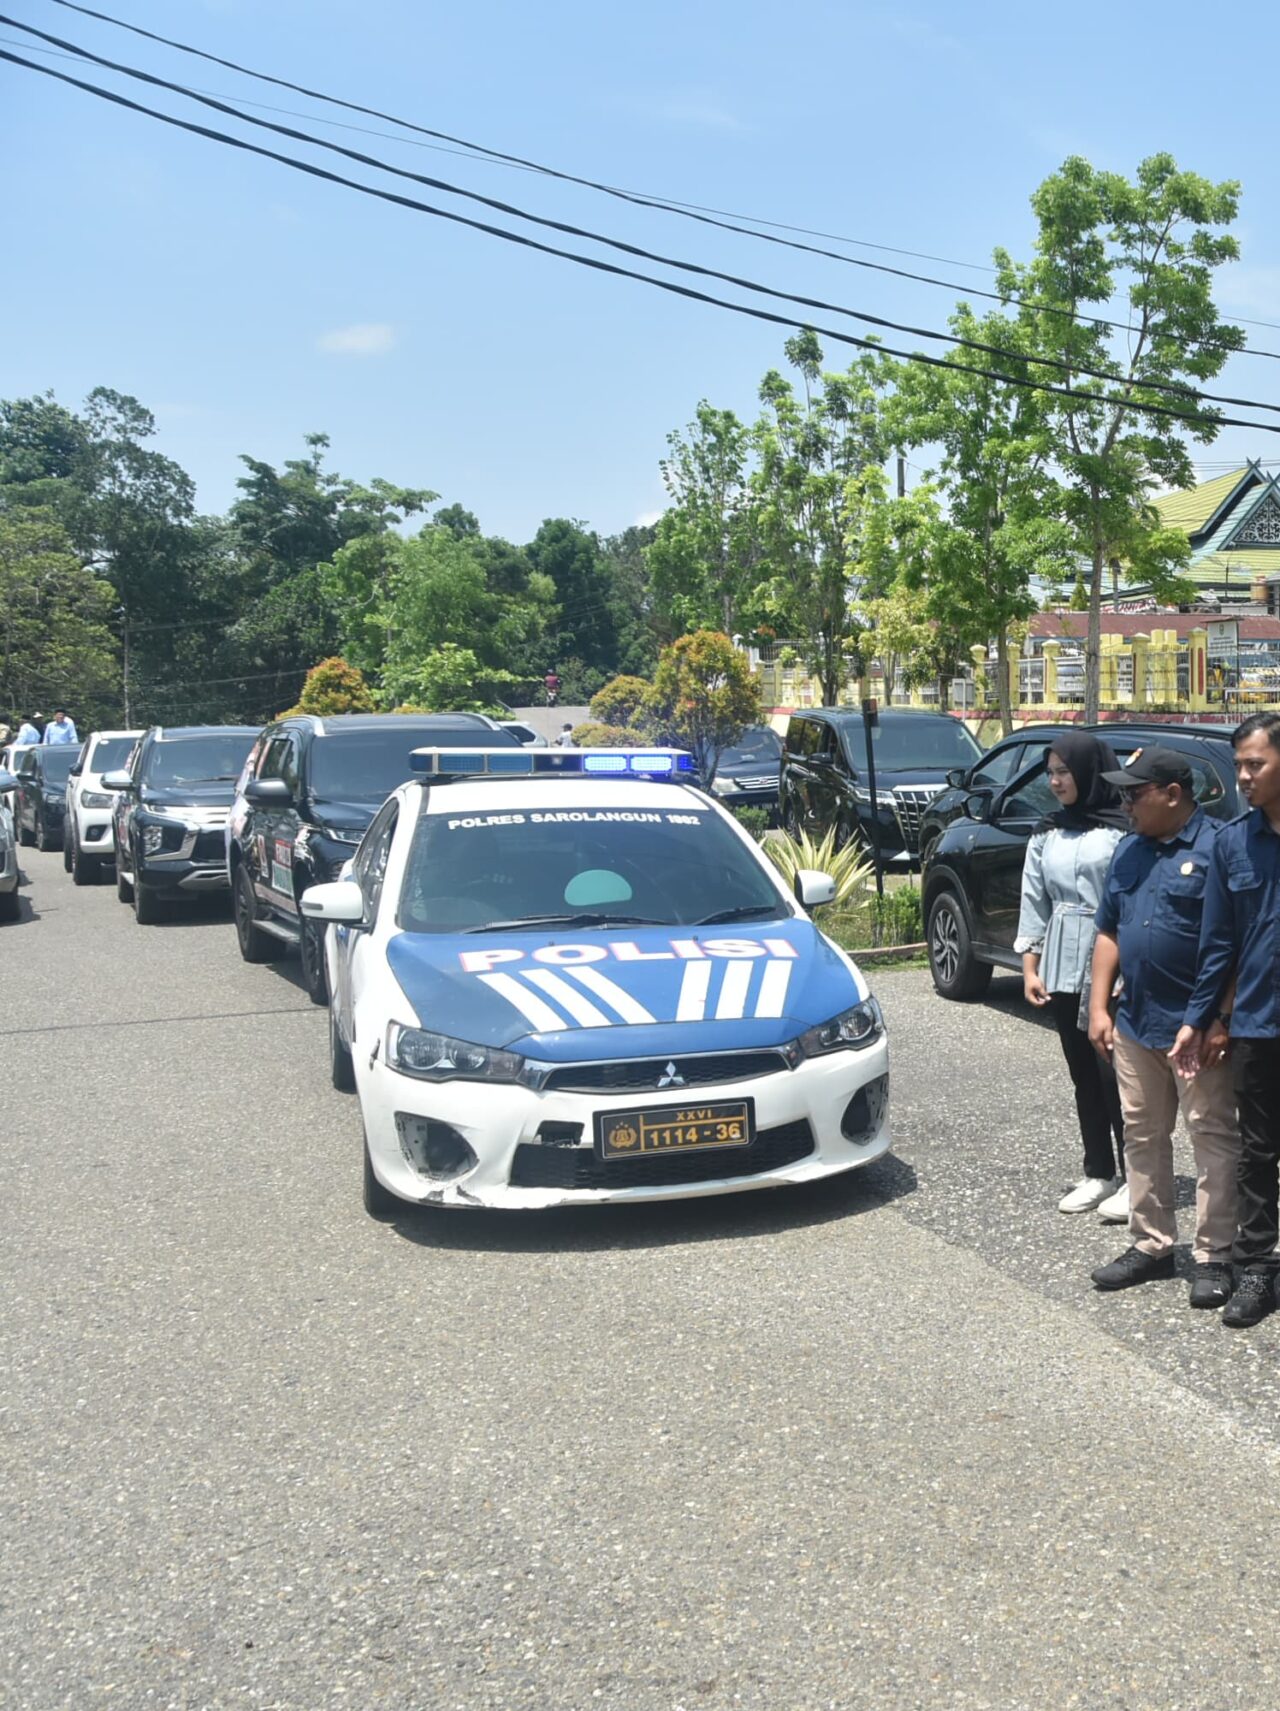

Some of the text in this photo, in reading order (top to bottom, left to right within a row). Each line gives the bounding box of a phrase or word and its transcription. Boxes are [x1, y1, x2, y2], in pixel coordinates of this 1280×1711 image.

[448, 814, 525, 830] POLRES
[531, 811, 662, 823] SAROLANGUN
[459, 938, 800, 973] POLISI
[676, 1109, 713, 1121] XXVI
[650, 1126, 698, 1147] 1114
[716, 1122, 742, 1141] 36
